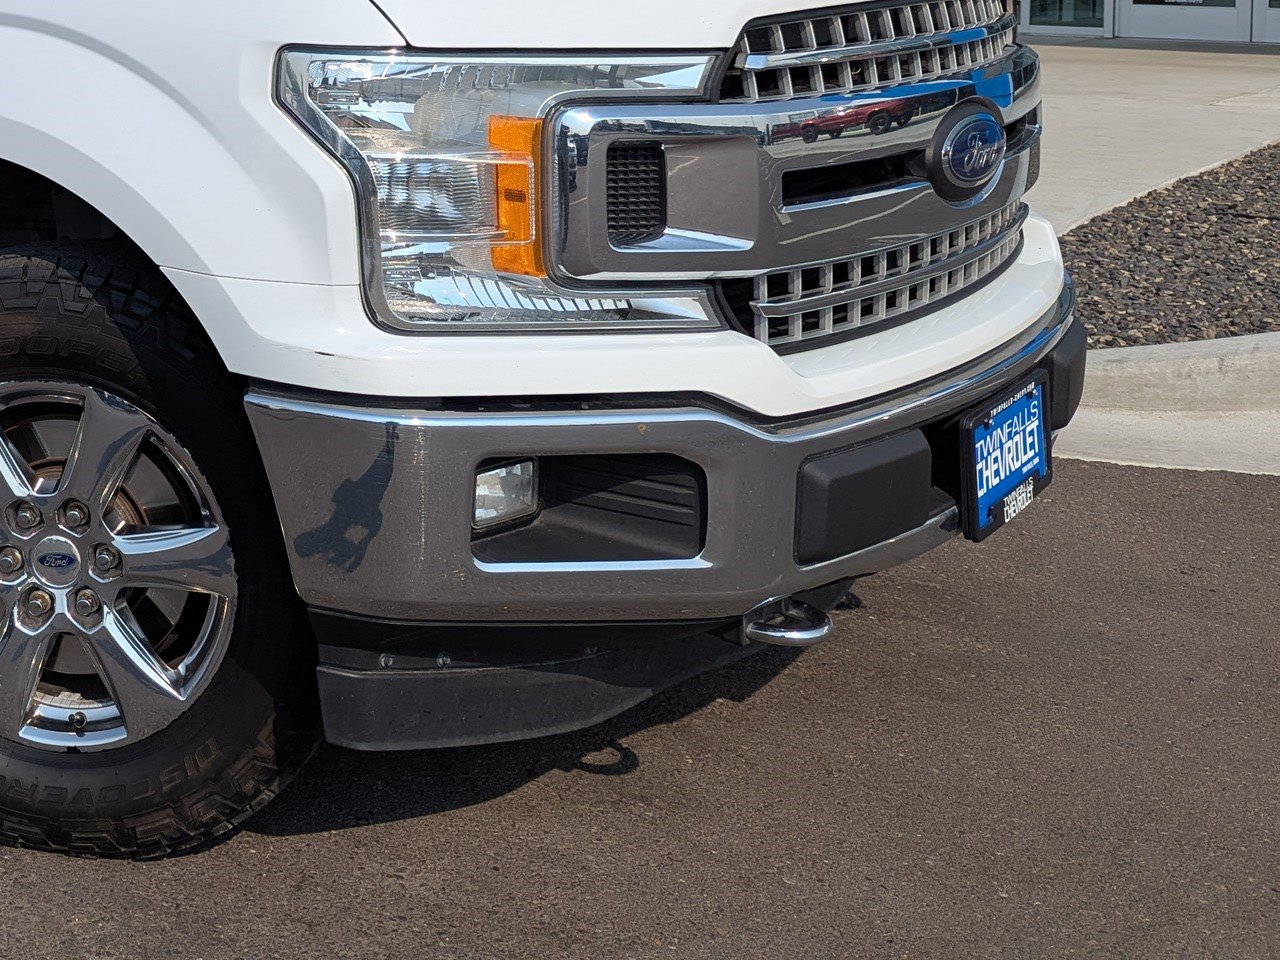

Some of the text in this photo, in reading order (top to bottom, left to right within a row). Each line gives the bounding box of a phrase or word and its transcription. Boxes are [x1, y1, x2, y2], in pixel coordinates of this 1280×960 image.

[964, 131, 998, 173] Ford
[975, 401, 1039, 463] TWINFALLS
[976, 419, 1039, 498] CHEVROLET
[1003, 476, 1033, 506] TWINFALLS
[1003, 486, 1034, 523] CHEVROLET
[43, 554, 69, 568] Ford
